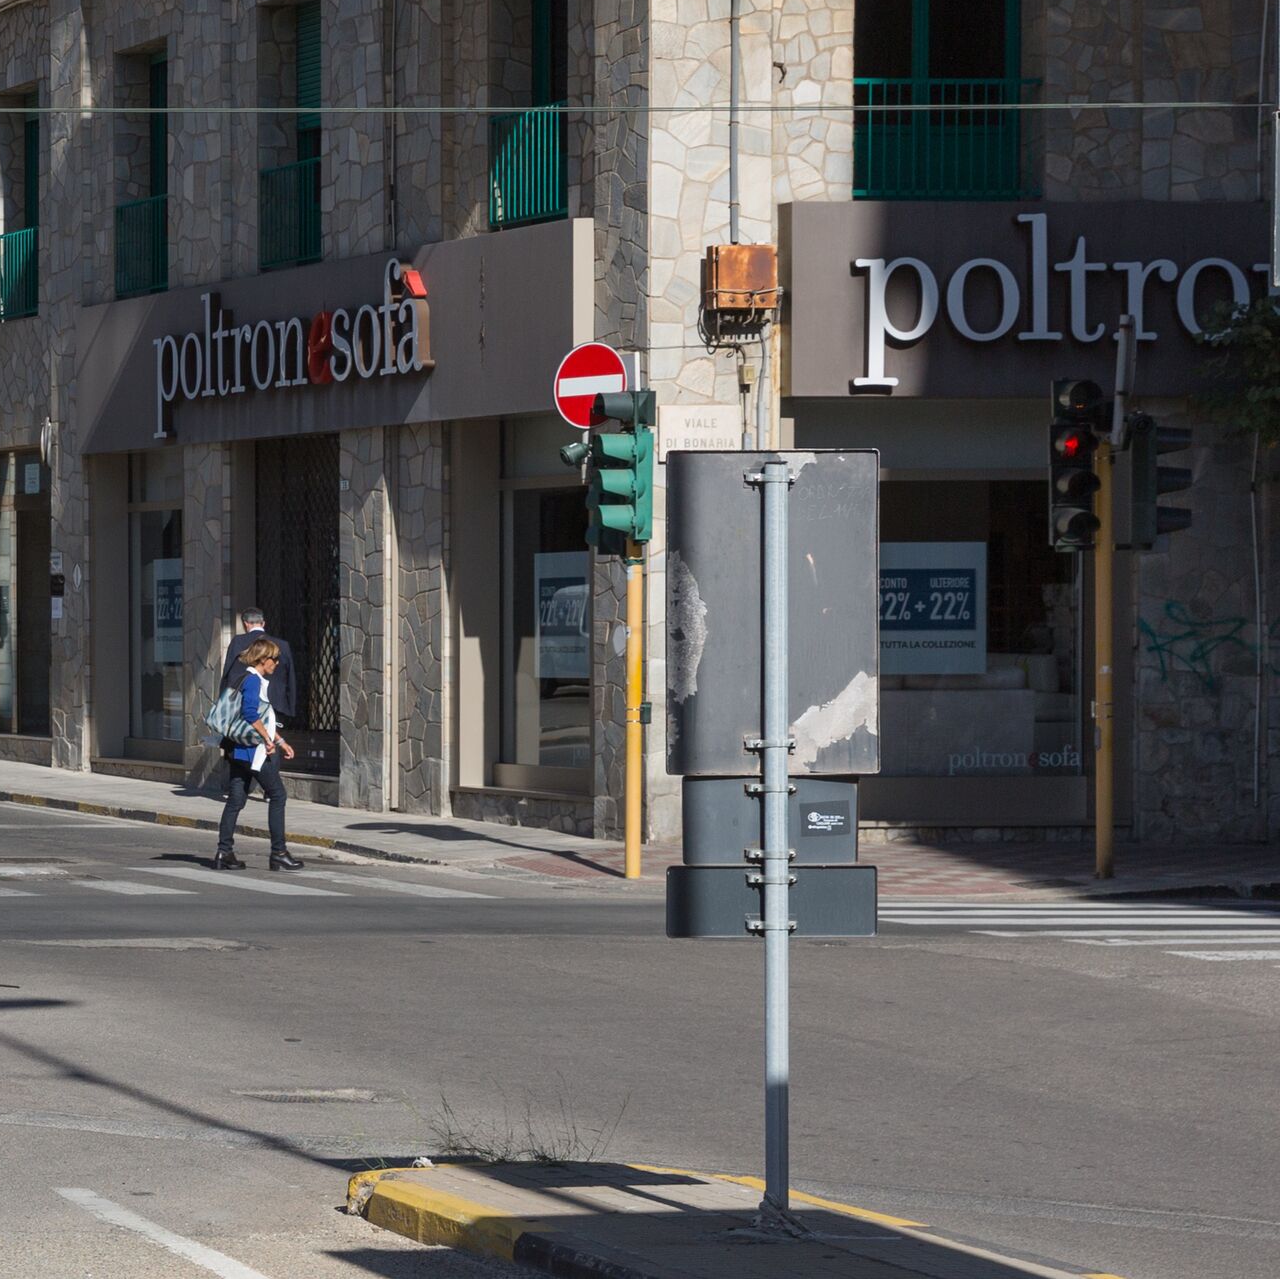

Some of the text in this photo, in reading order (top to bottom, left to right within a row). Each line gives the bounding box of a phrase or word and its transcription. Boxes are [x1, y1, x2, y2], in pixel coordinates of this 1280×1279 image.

[854, 212, 1280, 387] poltro
[684, 418, 718, 429] VIALE
[666, 438, 736, 449] DI BONARIA
[879, 577, 971, 589] CONTO ULTERIORE
[929, 592, 971, 620] 22%
[921, 640, 976, 649] COLLEZIONE
